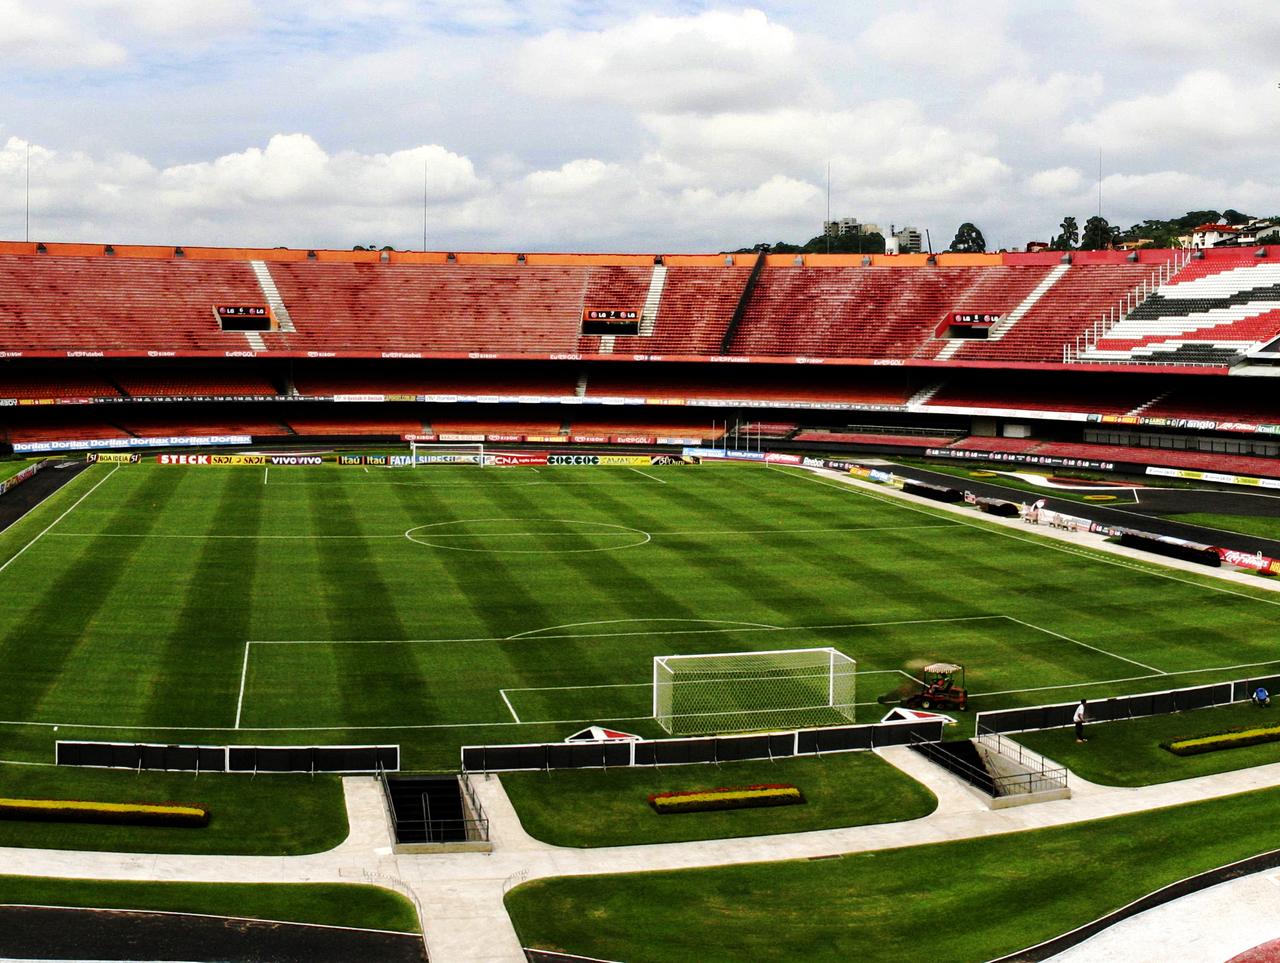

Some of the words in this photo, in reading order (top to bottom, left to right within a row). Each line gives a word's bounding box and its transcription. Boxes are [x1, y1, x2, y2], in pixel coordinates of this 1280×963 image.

[161, 455, 208, 464] STECK
[341, 455, 360, 464] Itaú
[366, 455, 385, 464] Itaú
